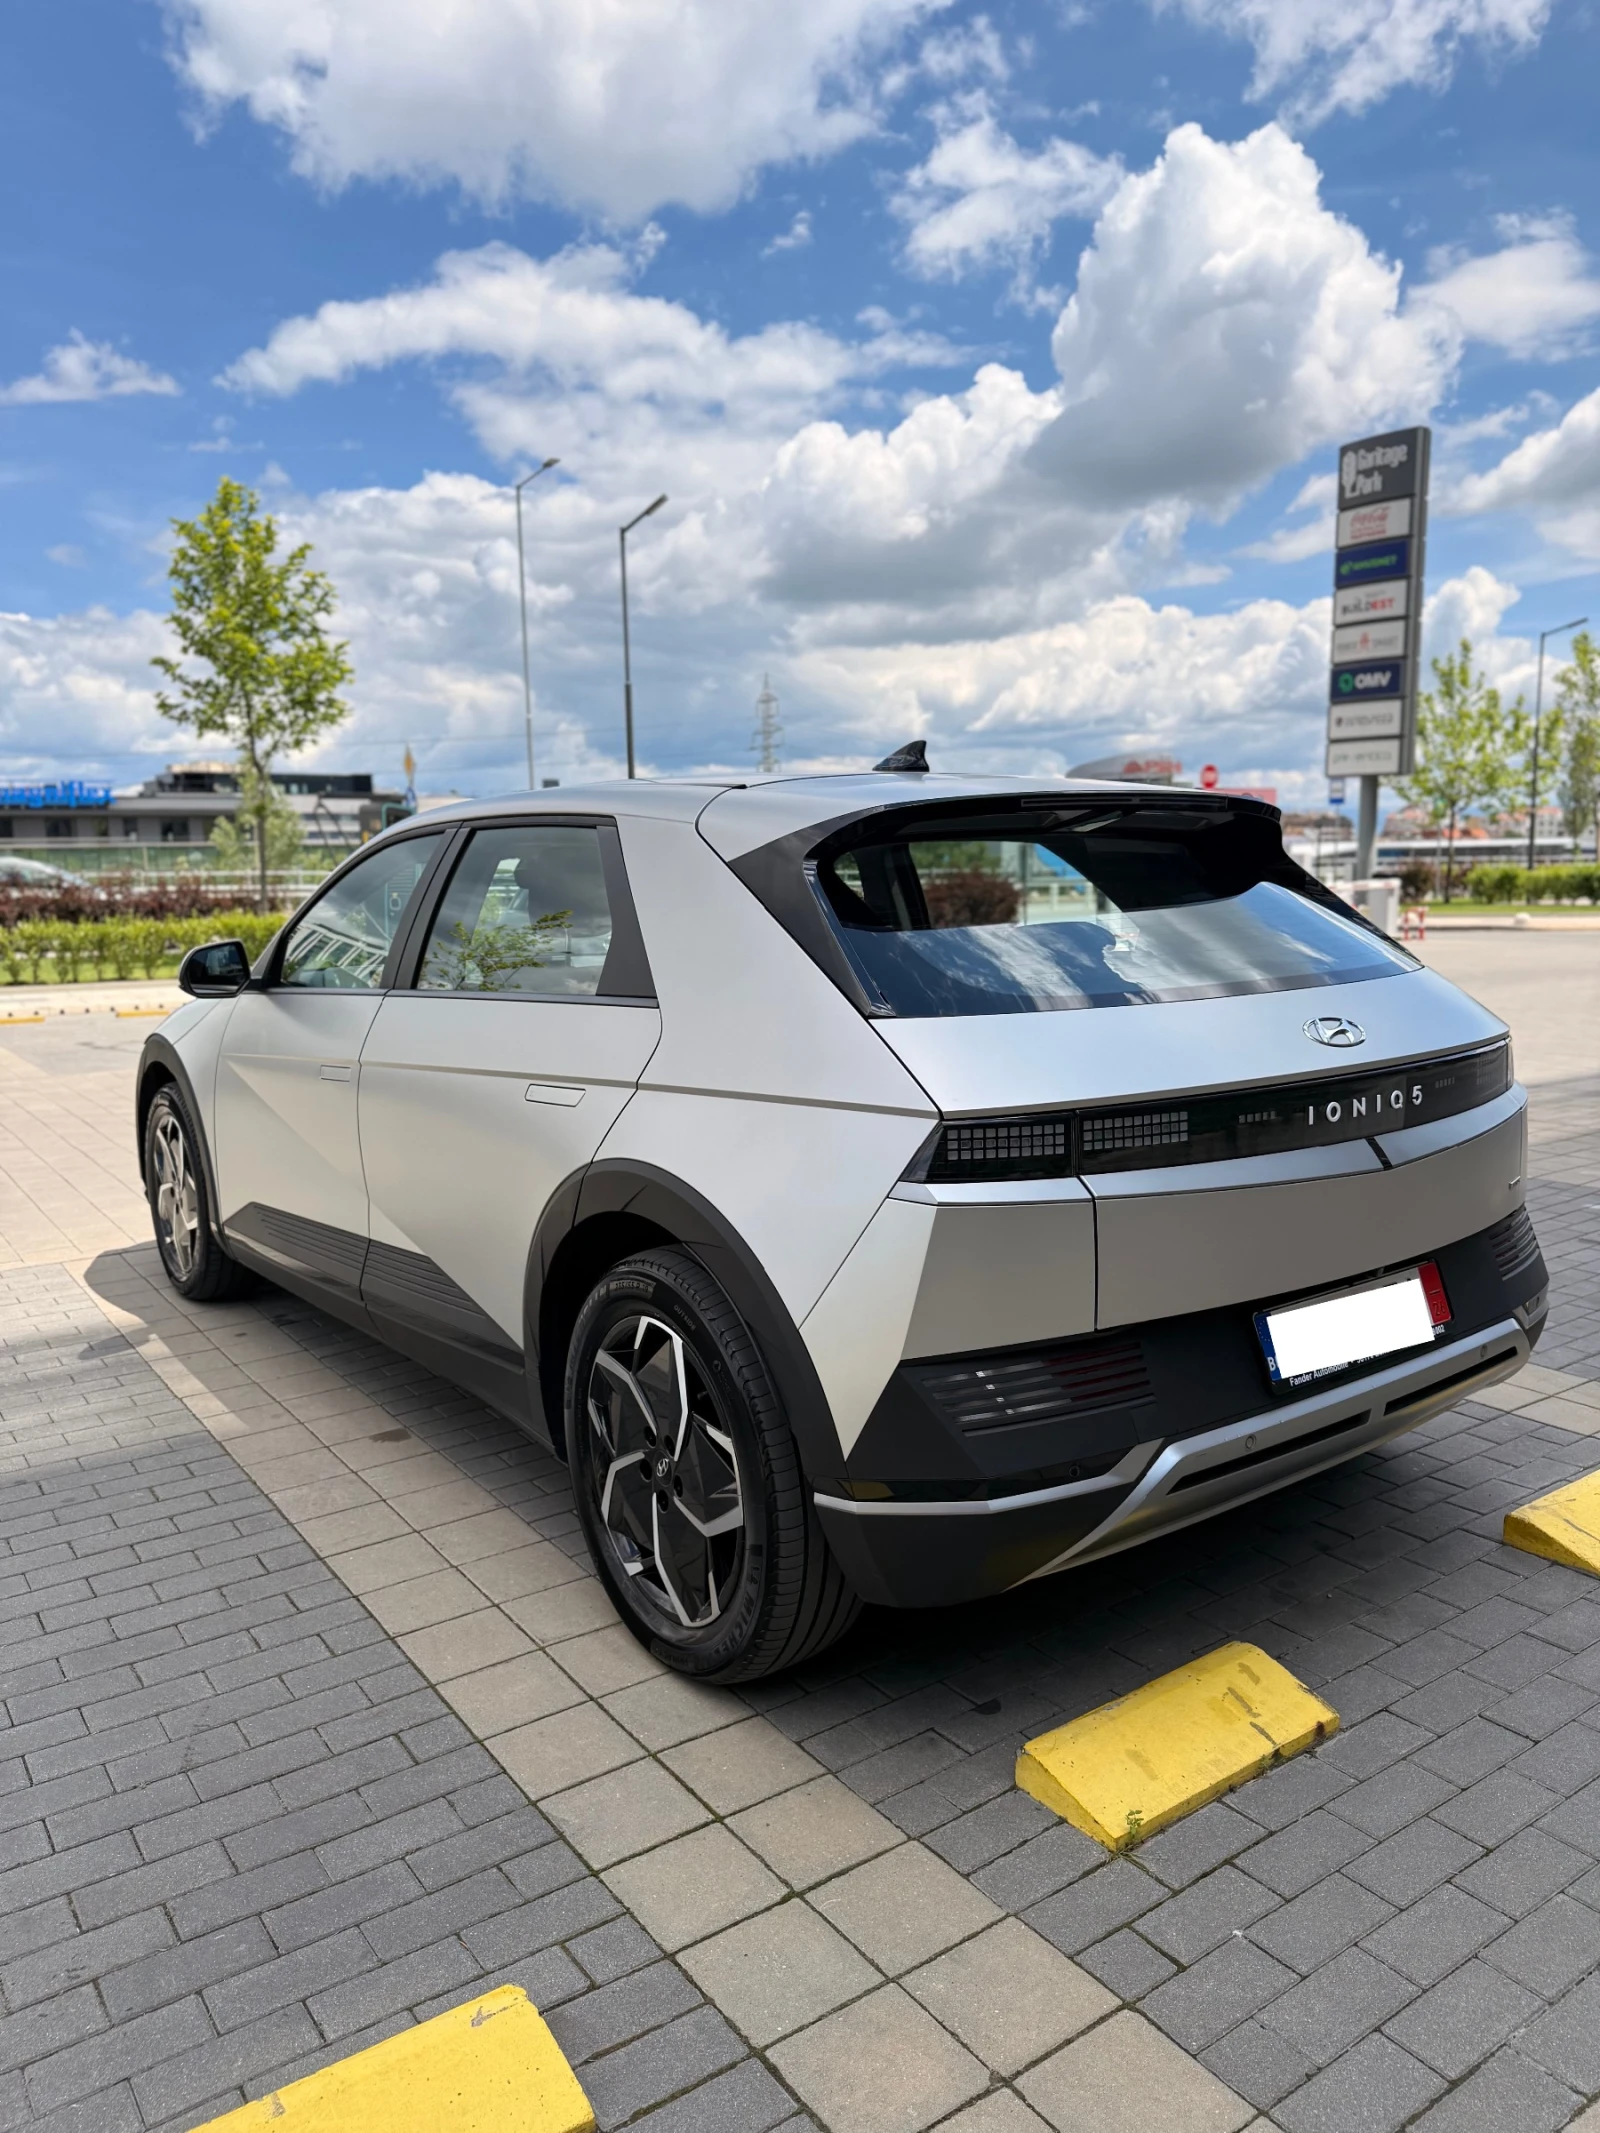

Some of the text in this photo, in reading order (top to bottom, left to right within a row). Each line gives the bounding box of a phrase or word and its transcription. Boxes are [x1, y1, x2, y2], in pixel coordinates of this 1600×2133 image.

[1358, 471, 1382, 495] Park
[1354, 671, 1392, 690] OMV
[673, 1304, 697, 1332] OUTSIDE
